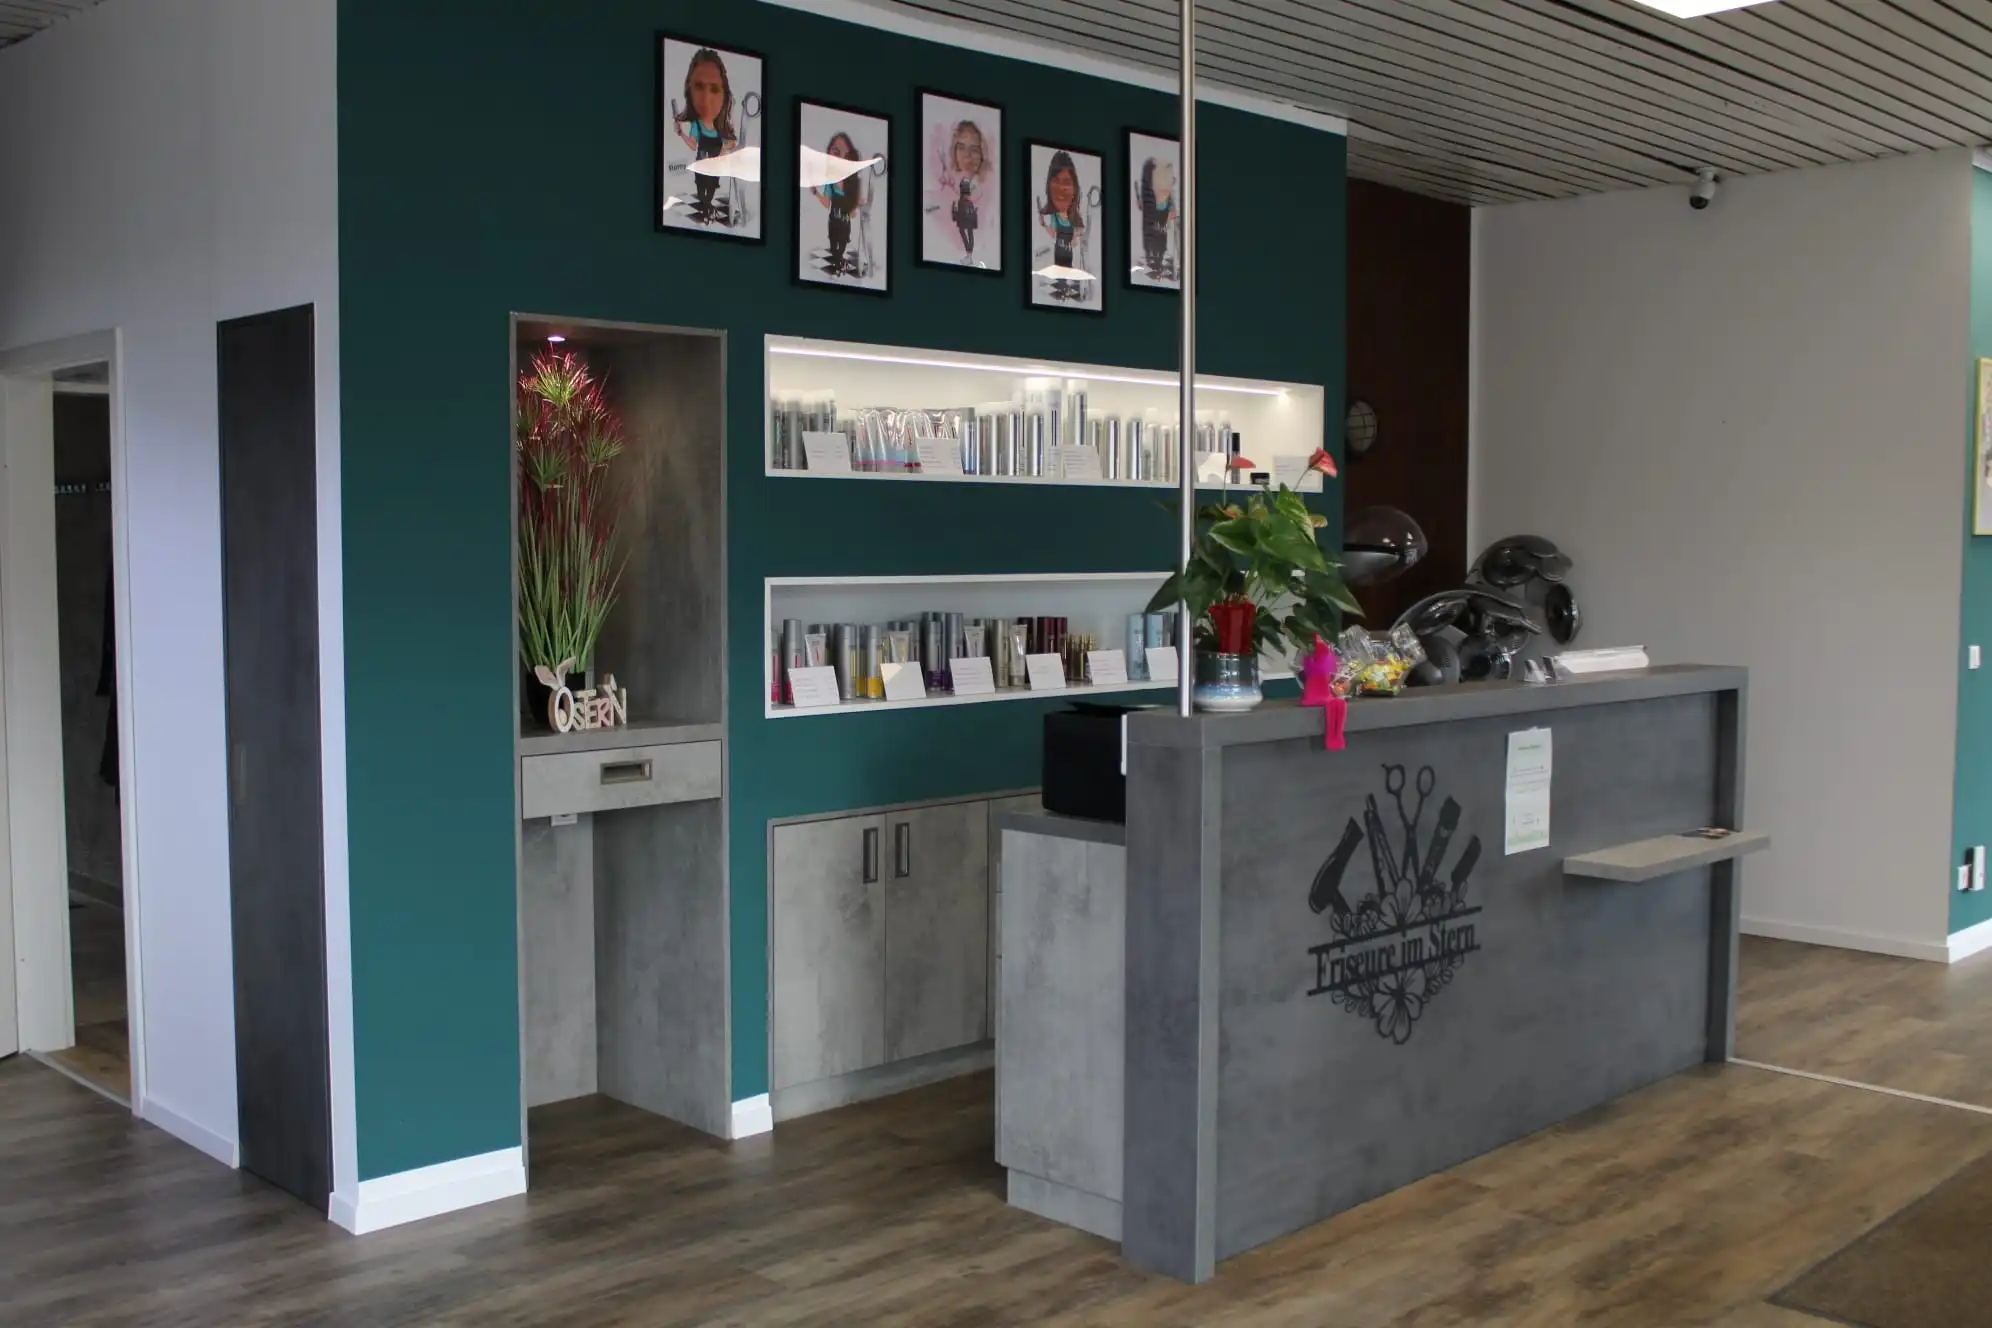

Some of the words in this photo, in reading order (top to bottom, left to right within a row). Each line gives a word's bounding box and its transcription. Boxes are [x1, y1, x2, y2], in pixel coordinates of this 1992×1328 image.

[1314, 942, 1396, 990] Friseure
[1401, 931, 1423, 965] im
[1428, 923, 1476, 959] Stern
